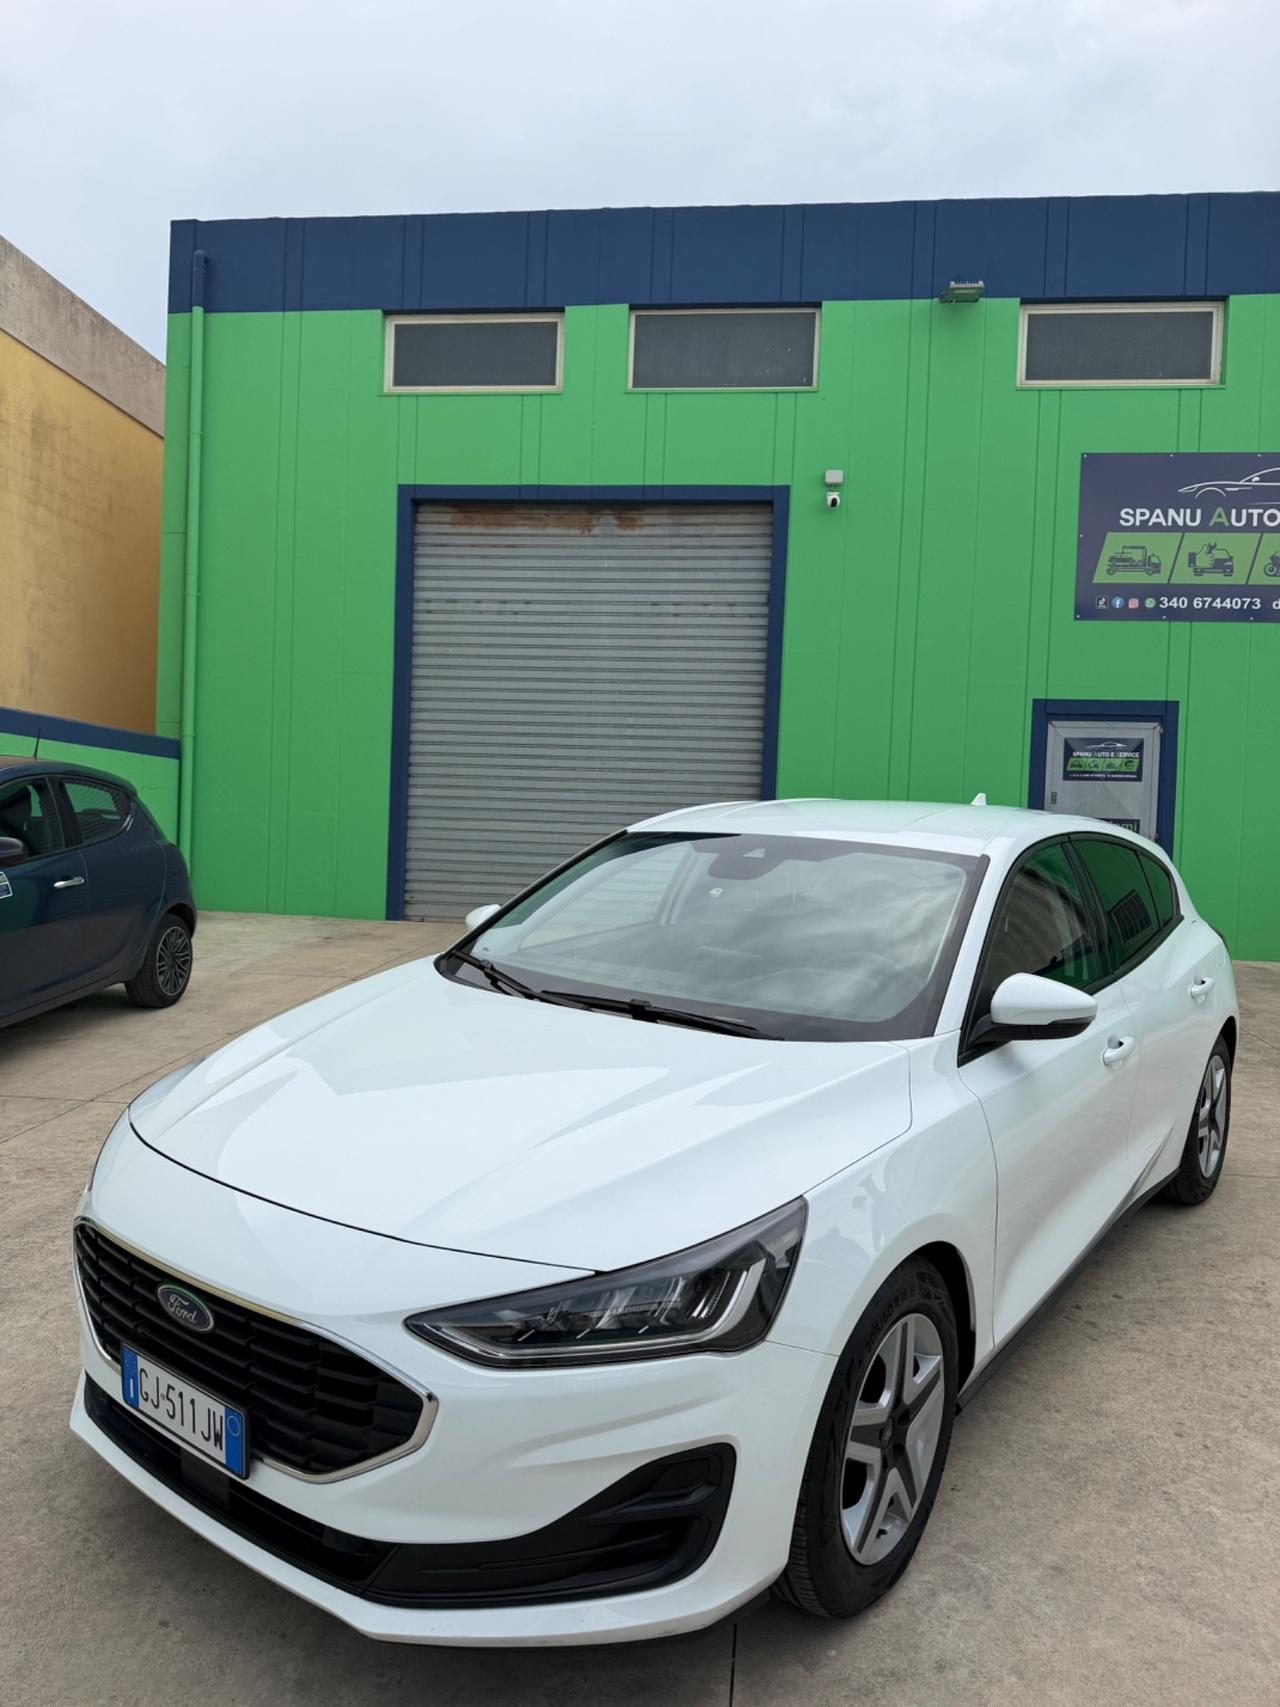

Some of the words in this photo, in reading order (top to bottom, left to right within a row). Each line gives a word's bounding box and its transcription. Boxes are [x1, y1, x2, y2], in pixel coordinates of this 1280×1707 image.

[1119, 508, 1202, 527] SPANU
[1209, 507, 1280, 527] AUTO
[1160, 597, 1188, 609] 340
[1193, 597, 1261, 610] 6744073
[168, 1294, 197, 1323] Ford
